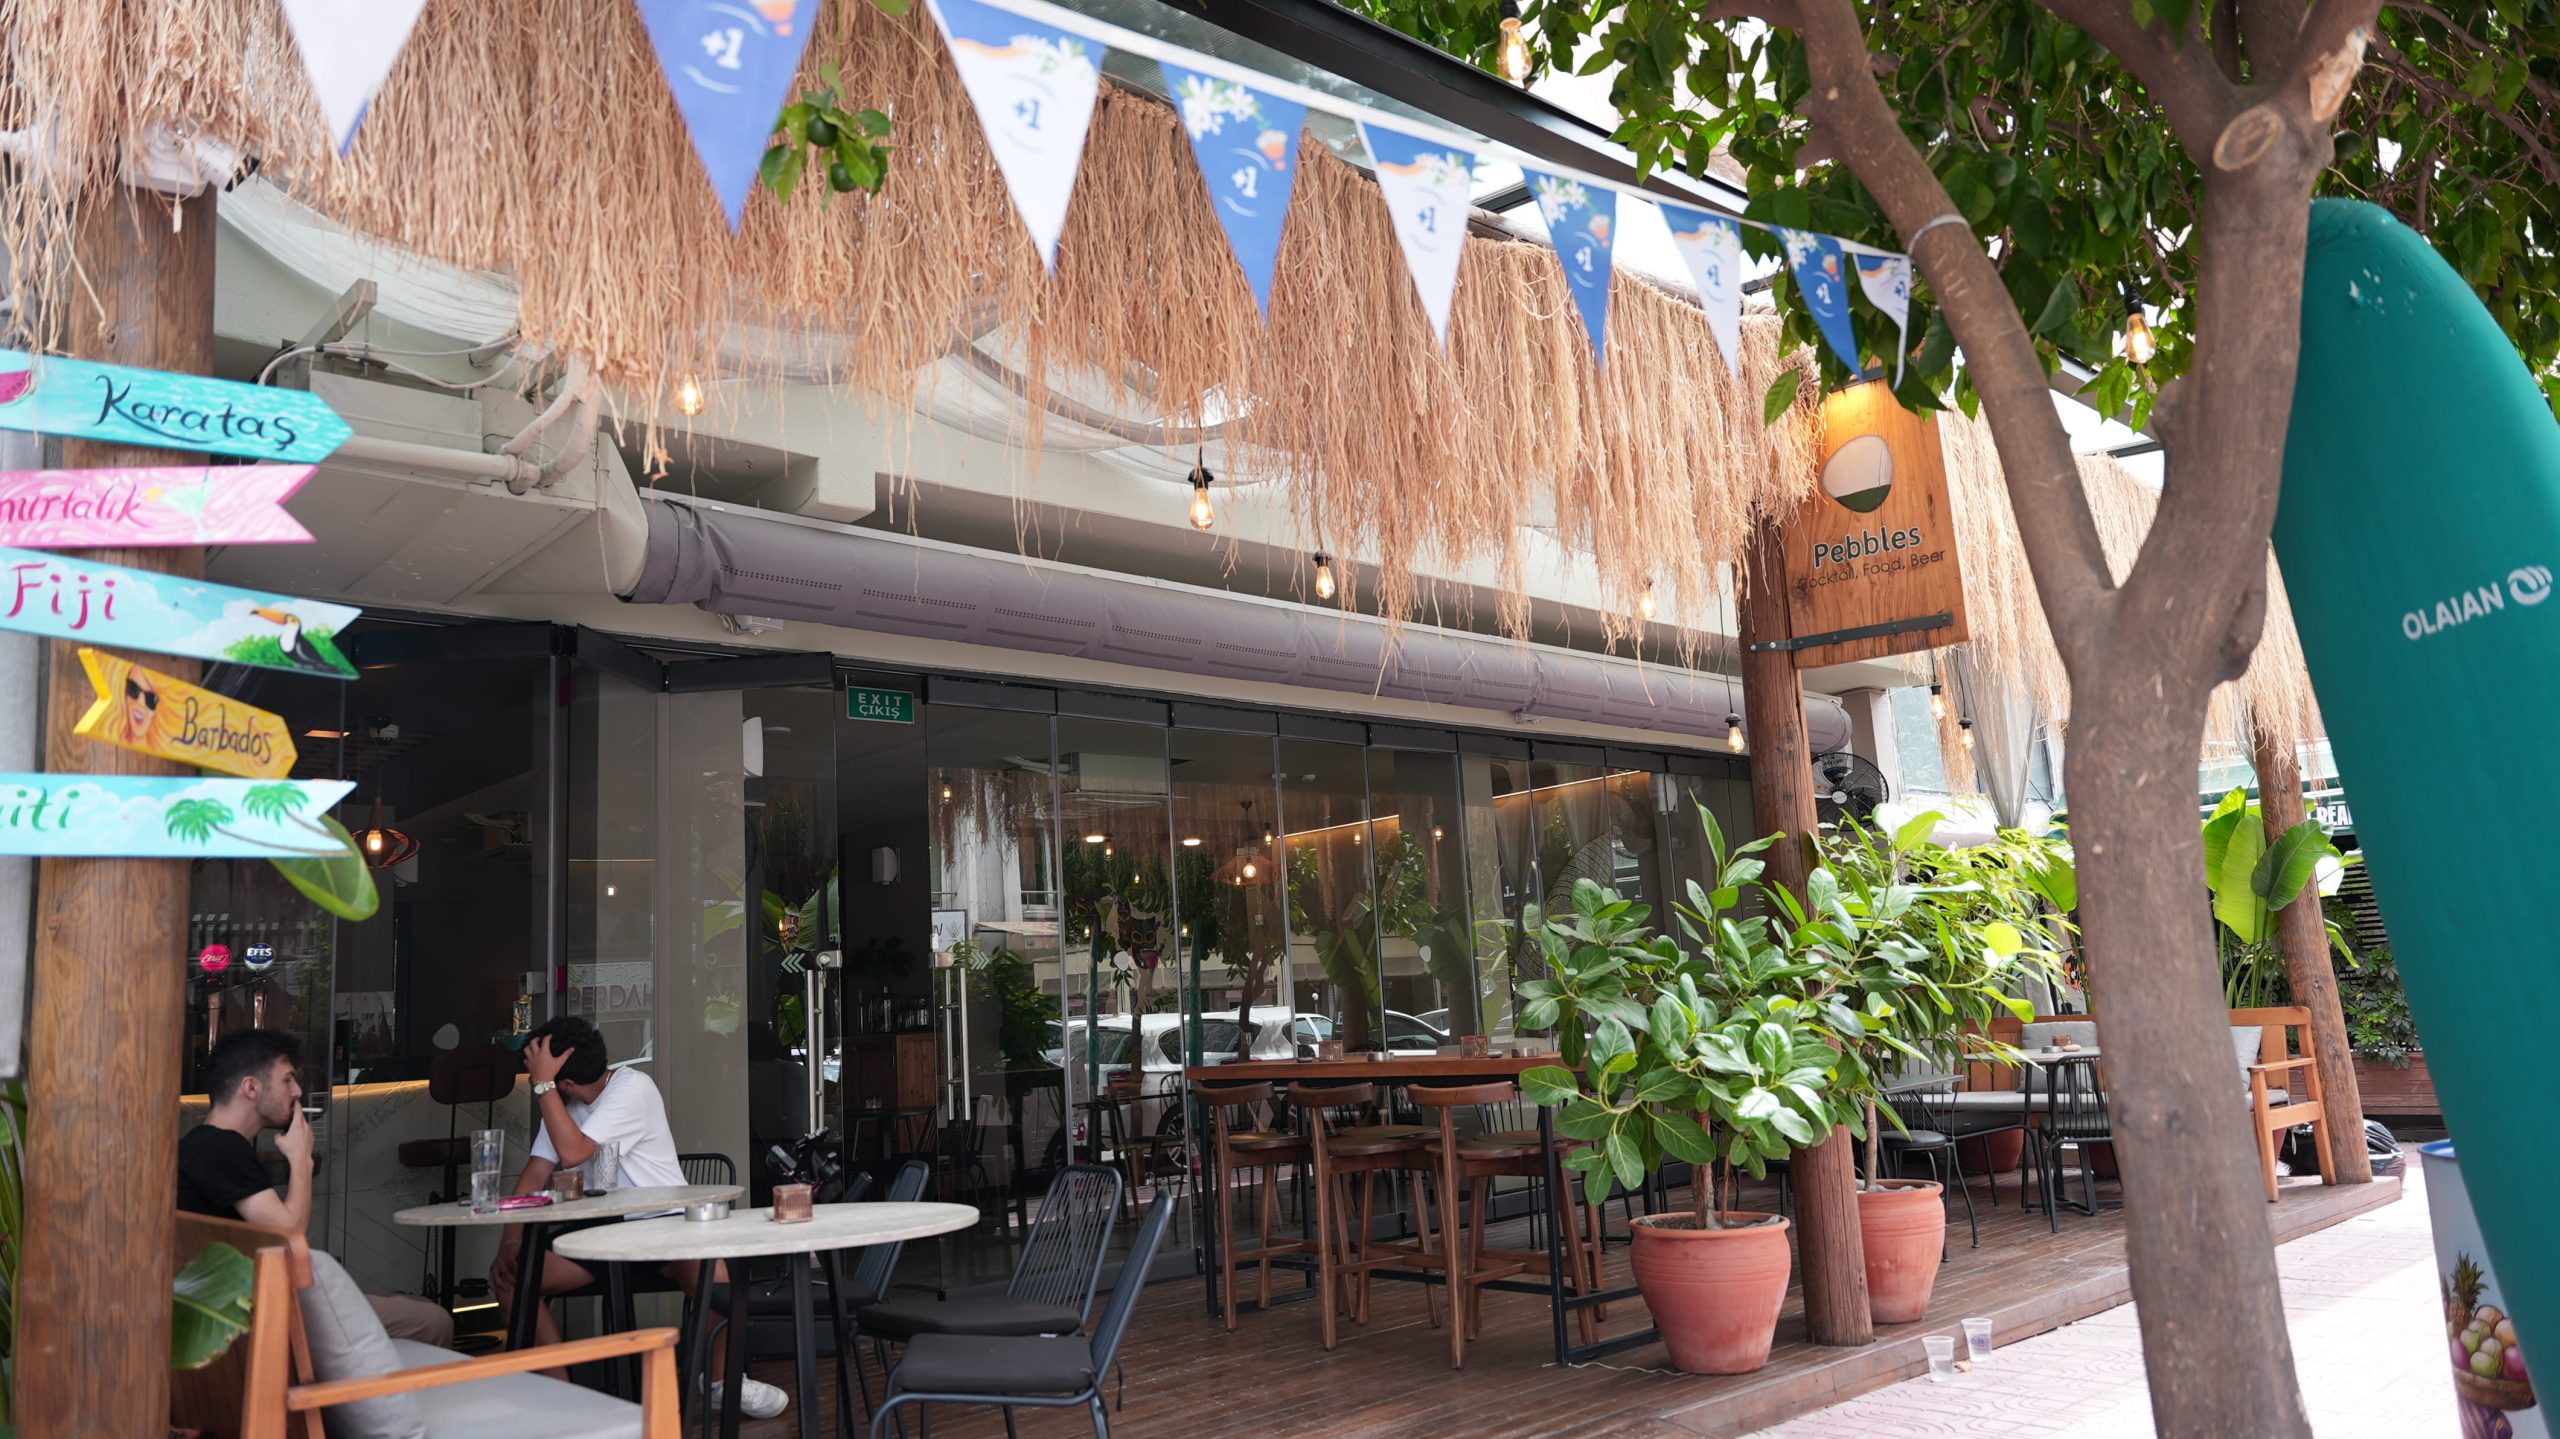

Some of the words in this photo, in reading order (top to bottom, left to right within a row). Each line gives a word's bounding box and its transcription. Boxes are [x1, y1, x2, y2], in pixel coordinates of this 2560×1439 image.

[701, 27, 744, 69] +1
[1013, 98, 1041, 131] +1
[1231, 166, 1258, 198] +1
[1417, 206, 1436, 233] +1
[1575, 246, 1593, 272] +1
[93, 375, 297, 451] Karataş
[1813, 525, 1922, 569] Pebbles
[1910, 549, 1946, 568] Beer
[5, 562, 117, 630] Fiji
[2402, 581, 2505, 640] OLAIAN
[858, 692, 902, 707] EXIT
[859, 704, 901, 719] ÇIKIŞ
[171, 696, 275, 764] Barbados
[0, 786, 80, 832] iti
[246, 947, 272, 957] EFES
